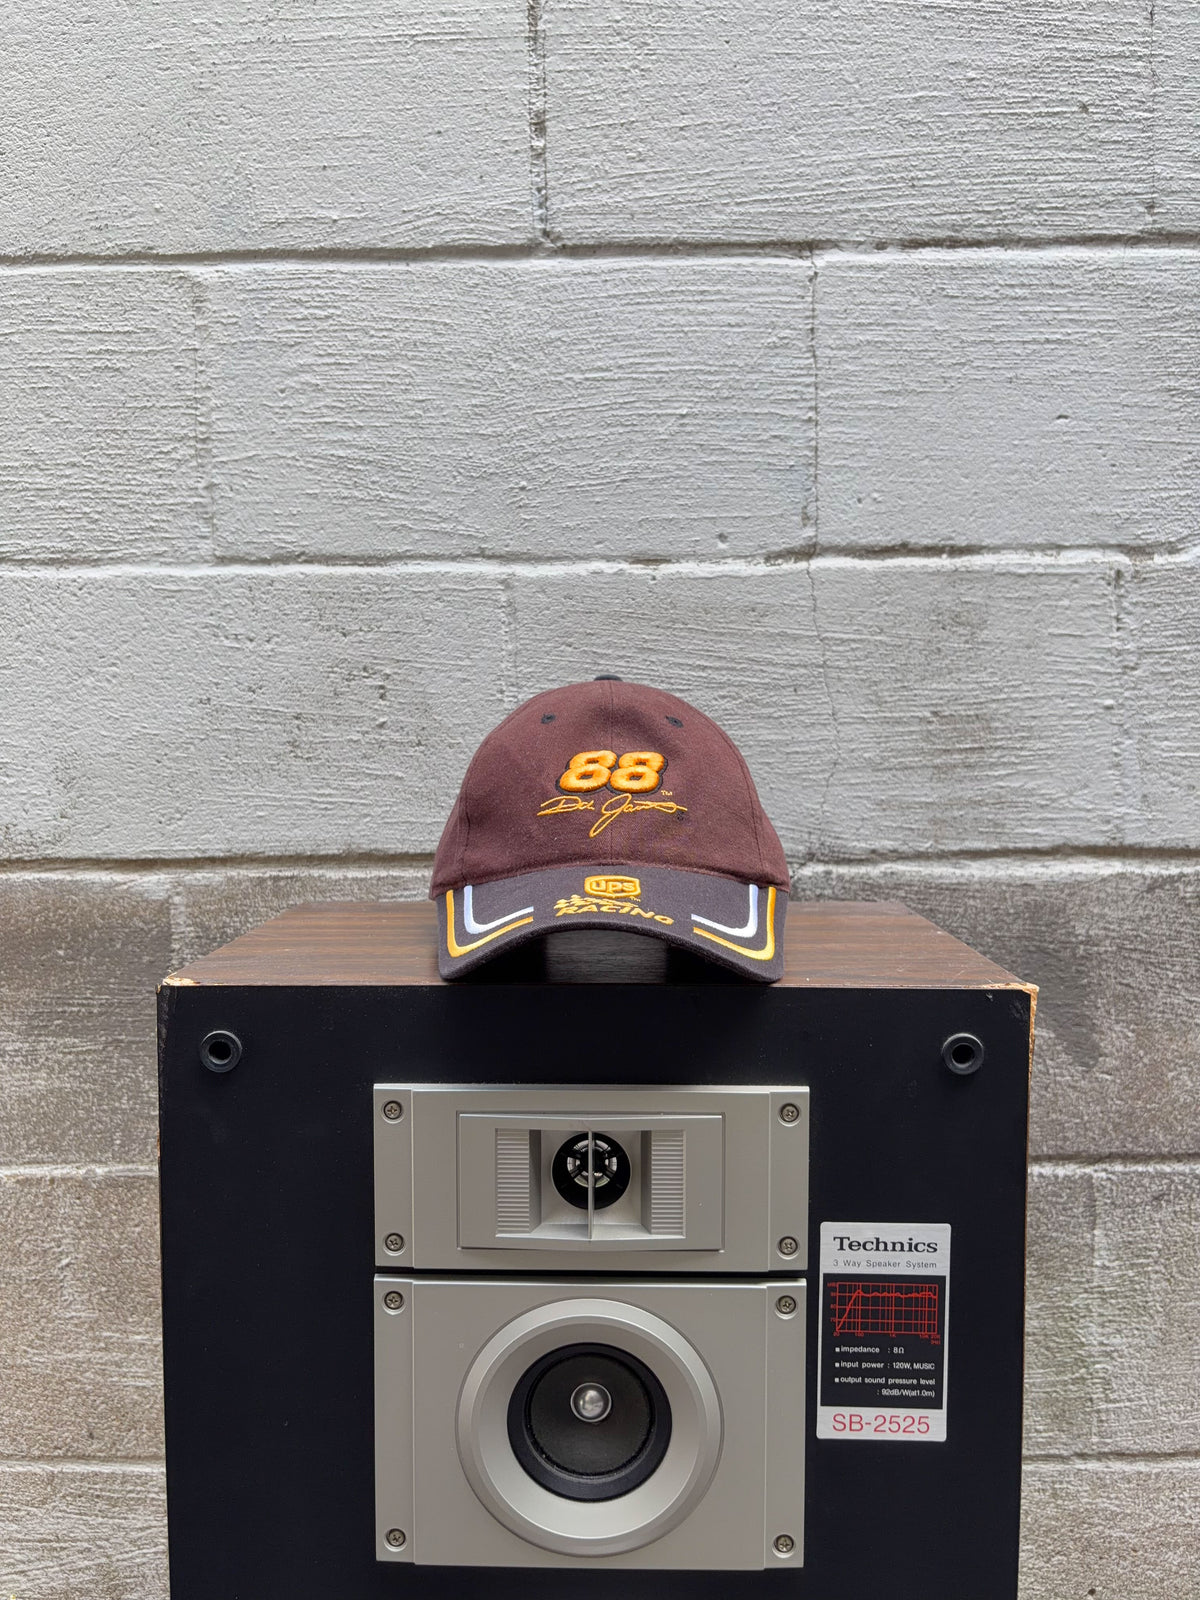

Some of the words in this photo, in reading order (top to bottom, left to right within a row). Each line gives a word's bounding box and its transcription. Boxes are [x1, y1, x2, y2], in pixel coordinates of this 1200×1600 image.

[557, 750, 666, 794] 88
[555, 904, 675, 925] RACING
[833, 1236, 938, 1253] Technics
[833, 1259, 839, 1267] 3
[843, 1259, 862, 1268] Way
[866, 1260, 901, 1268] Speaker
[905, 1260, 937, 1269] System
[840, 1345, 880, 1354] impedance
[893, 1346, 905, 1354] 8Ω
[840, 1360, 859, 1369] input
[861, 1361, 884, 1369] power
[913, 1362, 935, 1370] MUSIC
[840, 1376, 862, 1385] output
[832, 1413, 931, 1434] SB-2525
